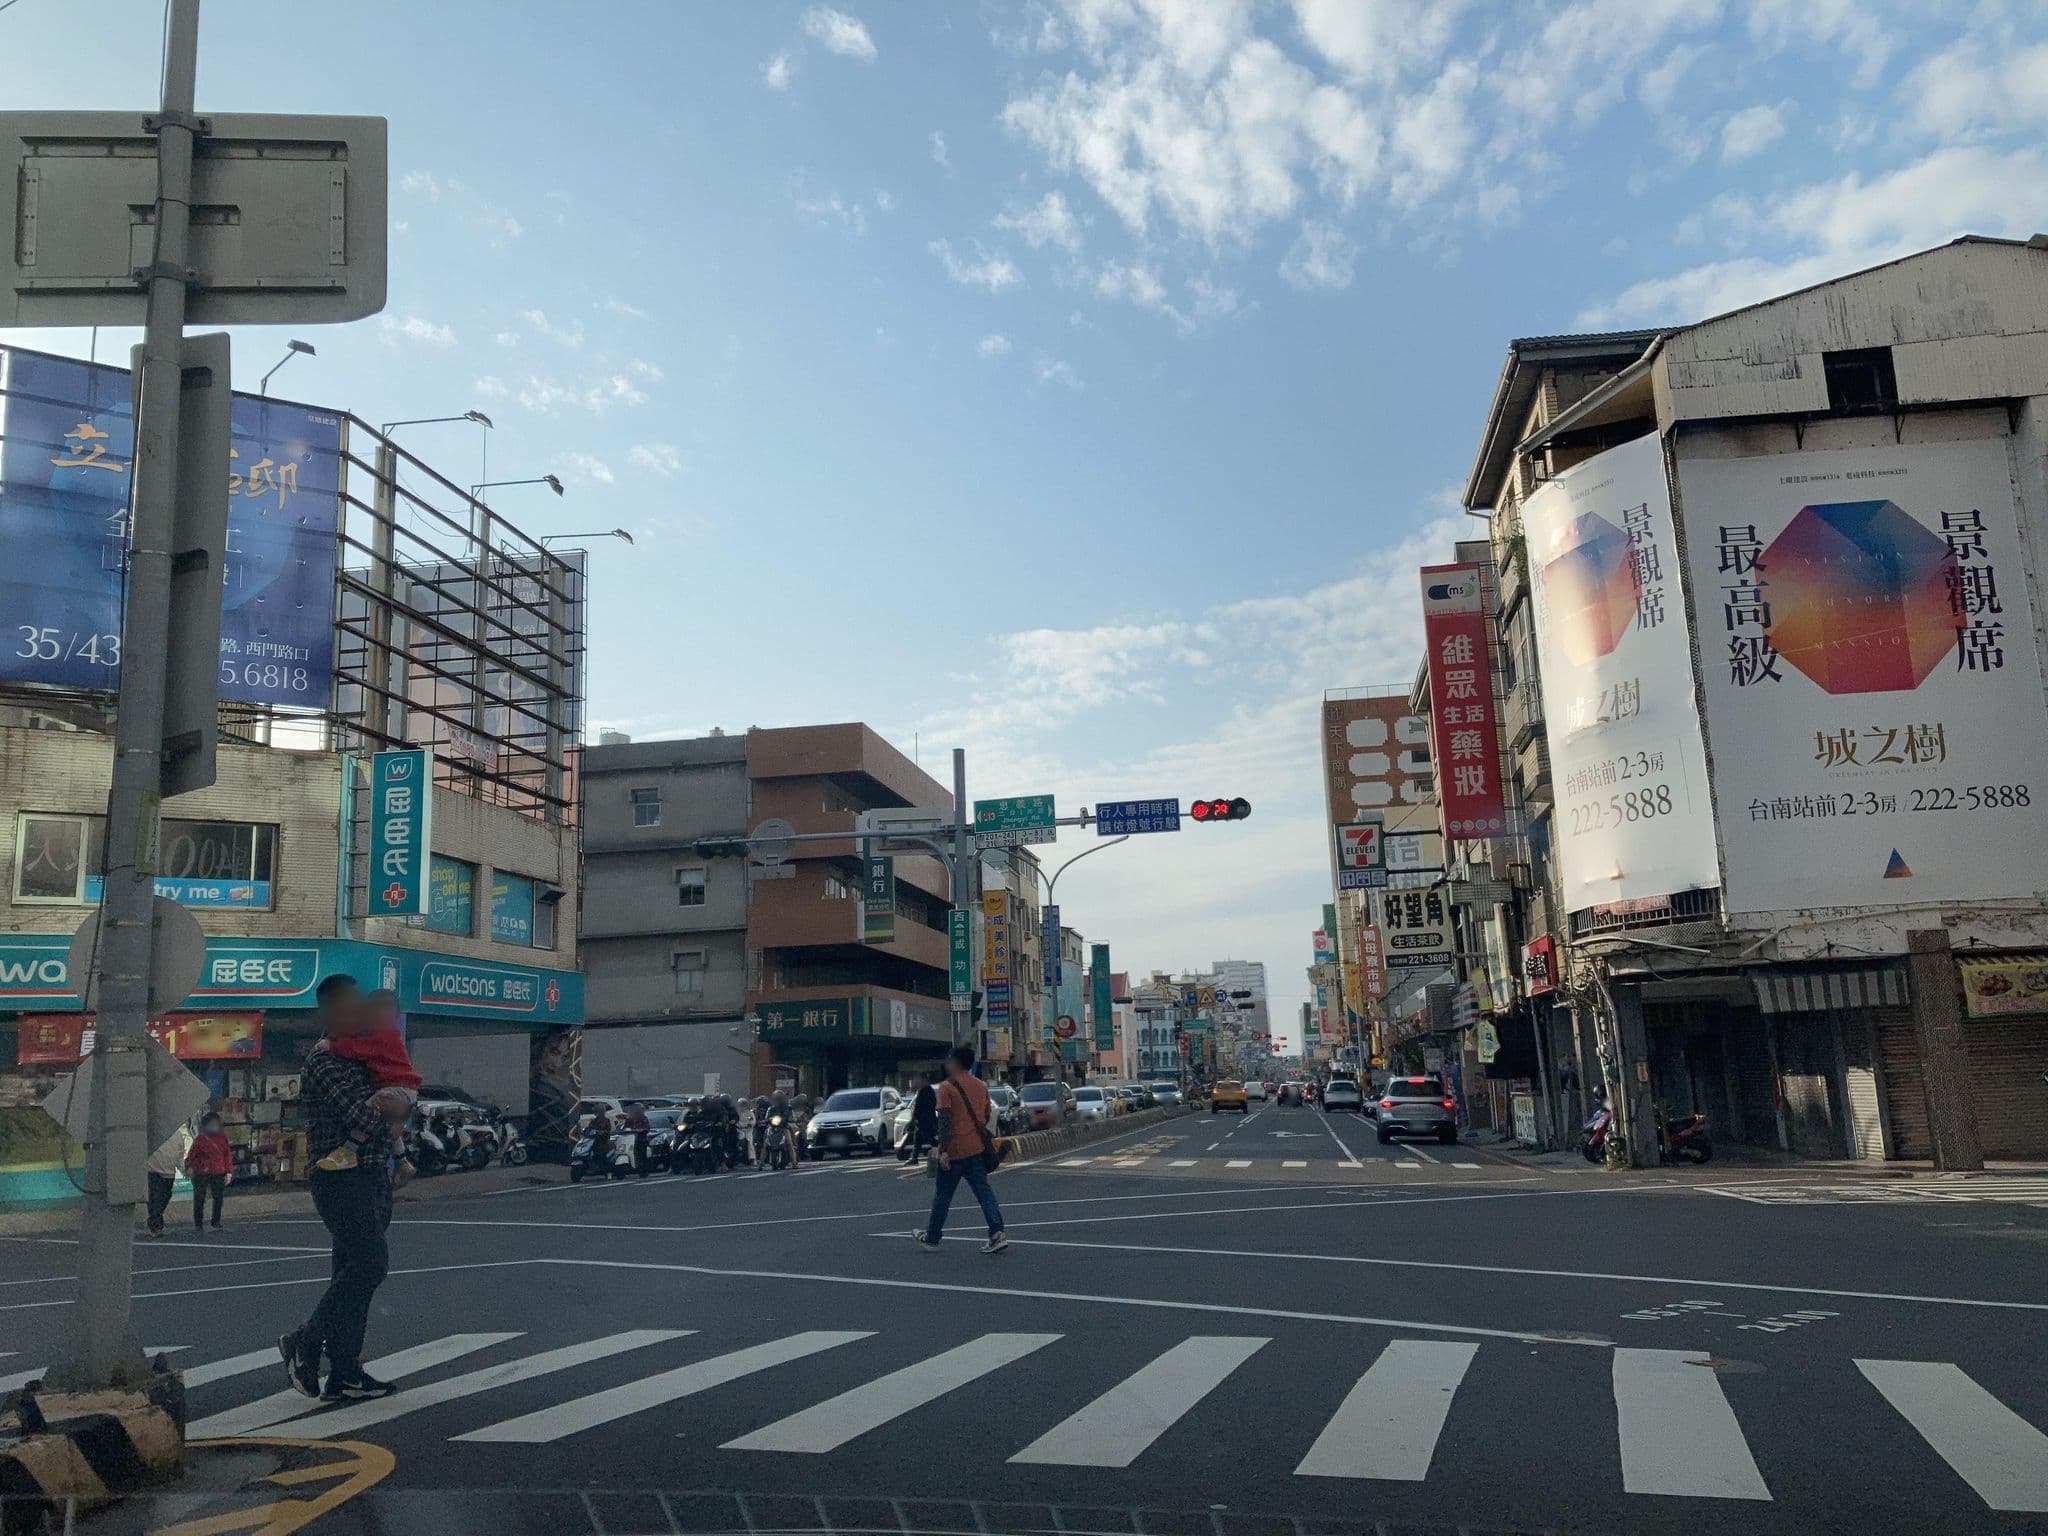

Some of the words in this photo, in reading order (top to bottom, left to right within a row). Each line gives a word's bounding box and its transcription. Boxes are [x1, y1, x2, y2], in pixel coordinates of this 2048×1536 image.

[1622, 502, 1665, 633] 景觀席
[1938, 508, 2004, 673] 景觀席
[1715, 524, 1782, 687] 最高級
[246, 641, 310, 661] 西門路口
[1813, 723, 1948, 769] 城之樹
[1099, 800, 1177, 818] 行人專用時相
[1570, 784, 1672, 836] 222-5888
[1910, 784, 2031, 812] 222-5888
[383, 786, 411, 876] 屈臣氏
[1100, 816, 1177, 833] 請依燈號行駛
[188, 887, 219, 899] me
[1384, 891, 1444, 930] 好望角
[1393, 935, 1441, 948] 生活茶飲
[211, 959, 292, 984] 屈臣氏
[1363, 930, 1381, 994] 鴨母寮市場
[431, 973, 496, 997] watsons
[503, 979, 531, 1001] 屈臣氏
[767, 1009, 838, 1029] 第一銀行
